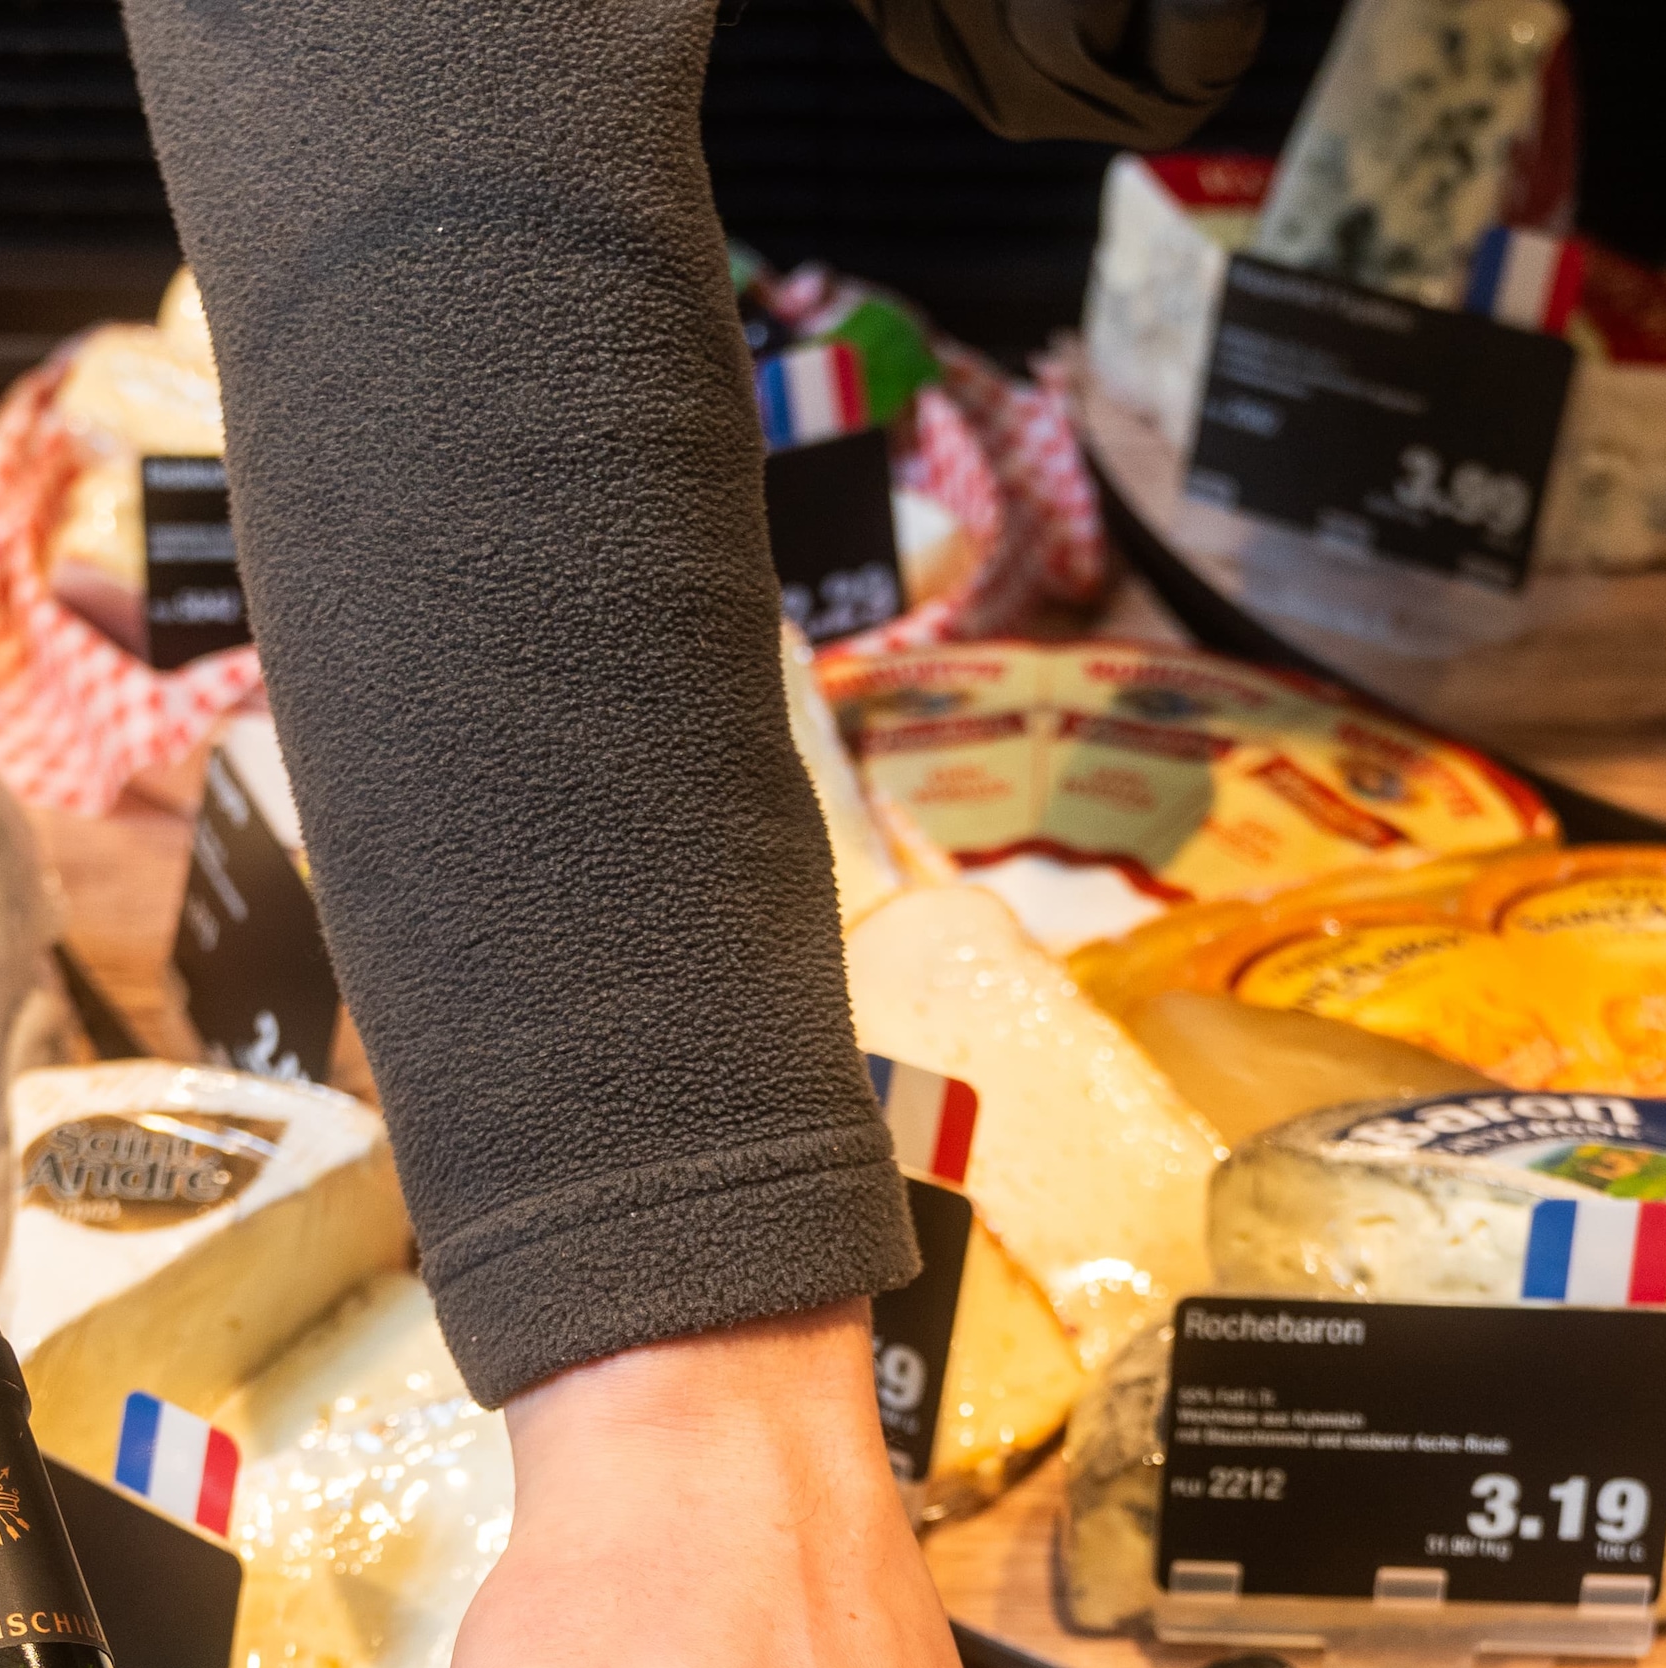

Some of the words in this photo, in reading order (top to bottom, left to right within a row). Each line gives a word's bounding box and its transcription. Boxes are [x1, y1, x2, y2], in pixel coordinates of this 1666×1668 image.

[1185, 1311, 1364, 1343] Rochebaron
[1207, 1465, 1287, 1500] 2212
[1467, 1473, 1651, 1543] 3.19
